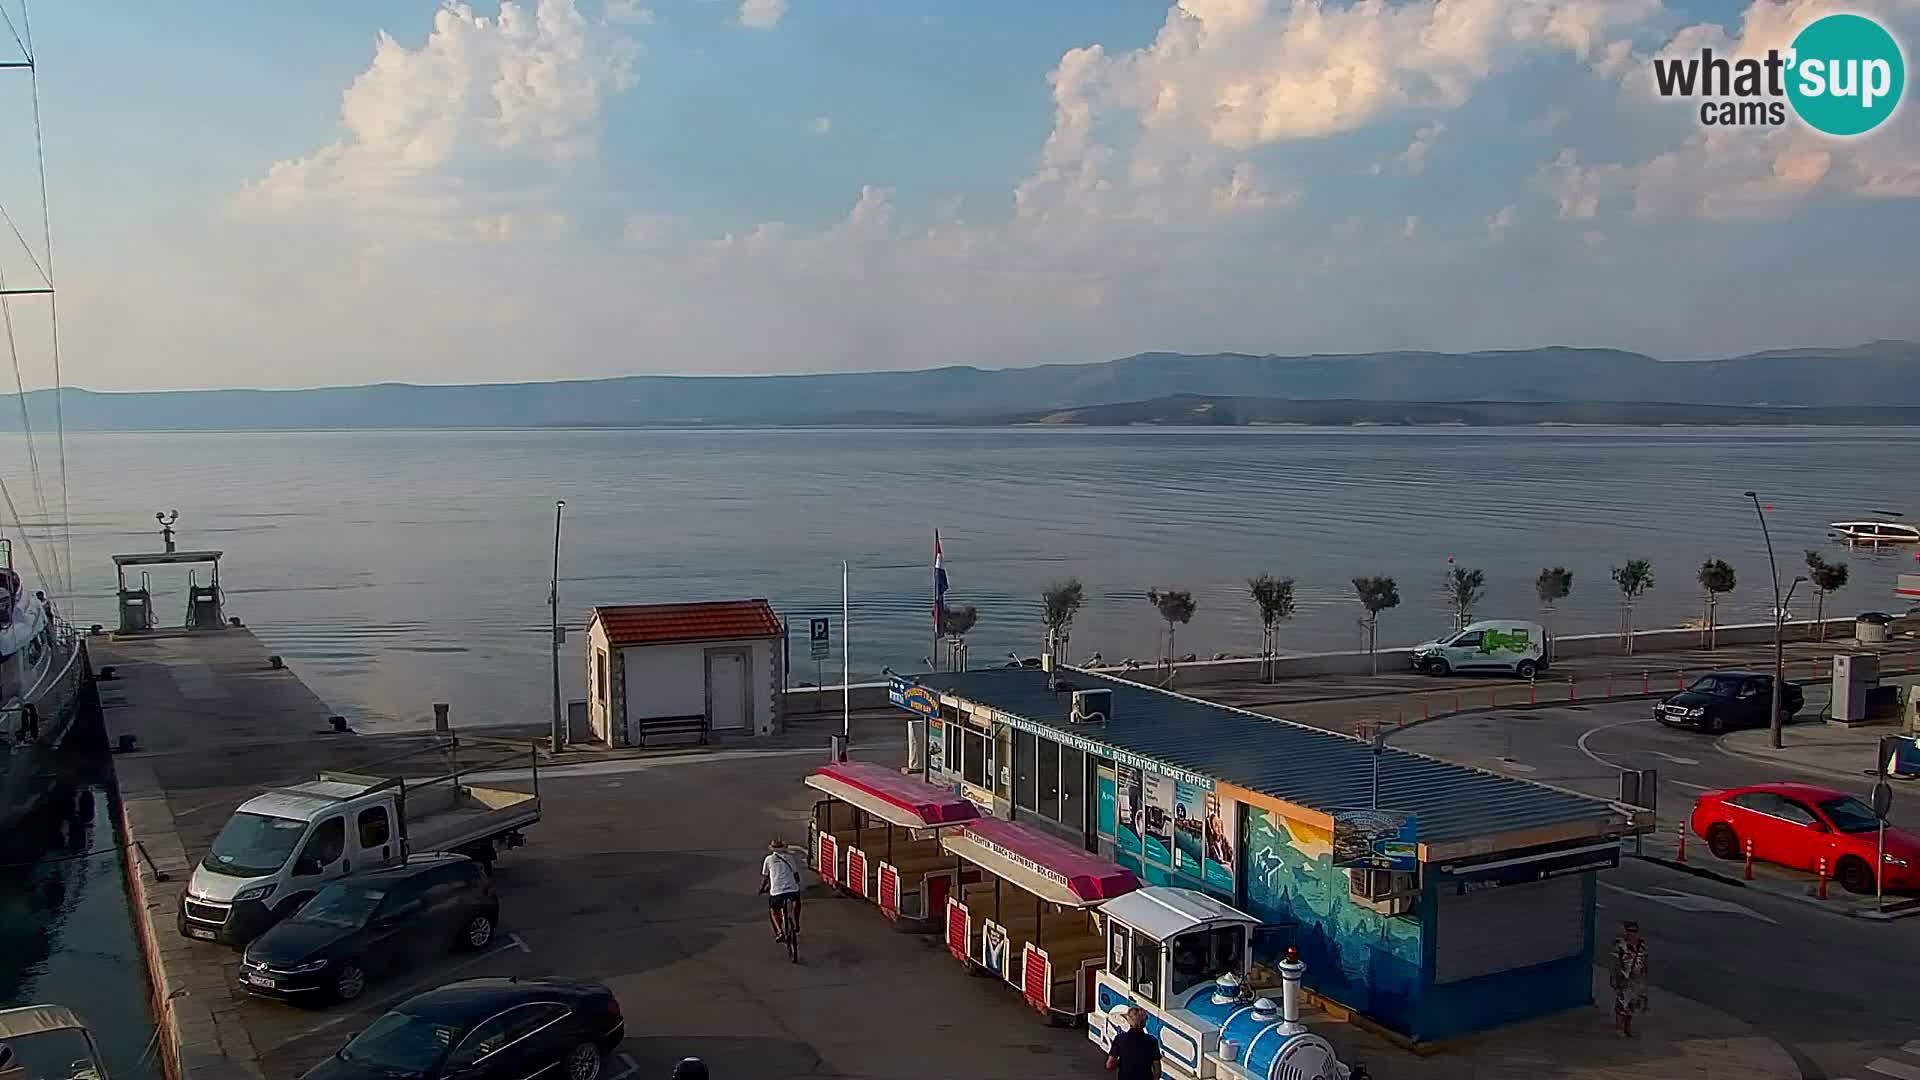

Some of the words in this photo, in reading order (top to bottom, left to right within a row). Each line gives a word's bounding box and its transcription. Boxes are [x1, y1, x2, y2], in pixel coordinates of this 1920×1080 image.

[815, 622, 825, 637] P
[1037, 725, 1074, 747] AUTOBUSNA
[1074, 738, 1103, 755] POSTAJA
[1112, 750, 1126, 762] BUS
[1127, 755, 1158, 773] STATION
[1160, 765, 1184, 782] TICKET
[1185, 773, 1211, 790] OFFICE
[974, 835, 991, 848] CENTER
[1047, 870, 1067, 886] CENTER
